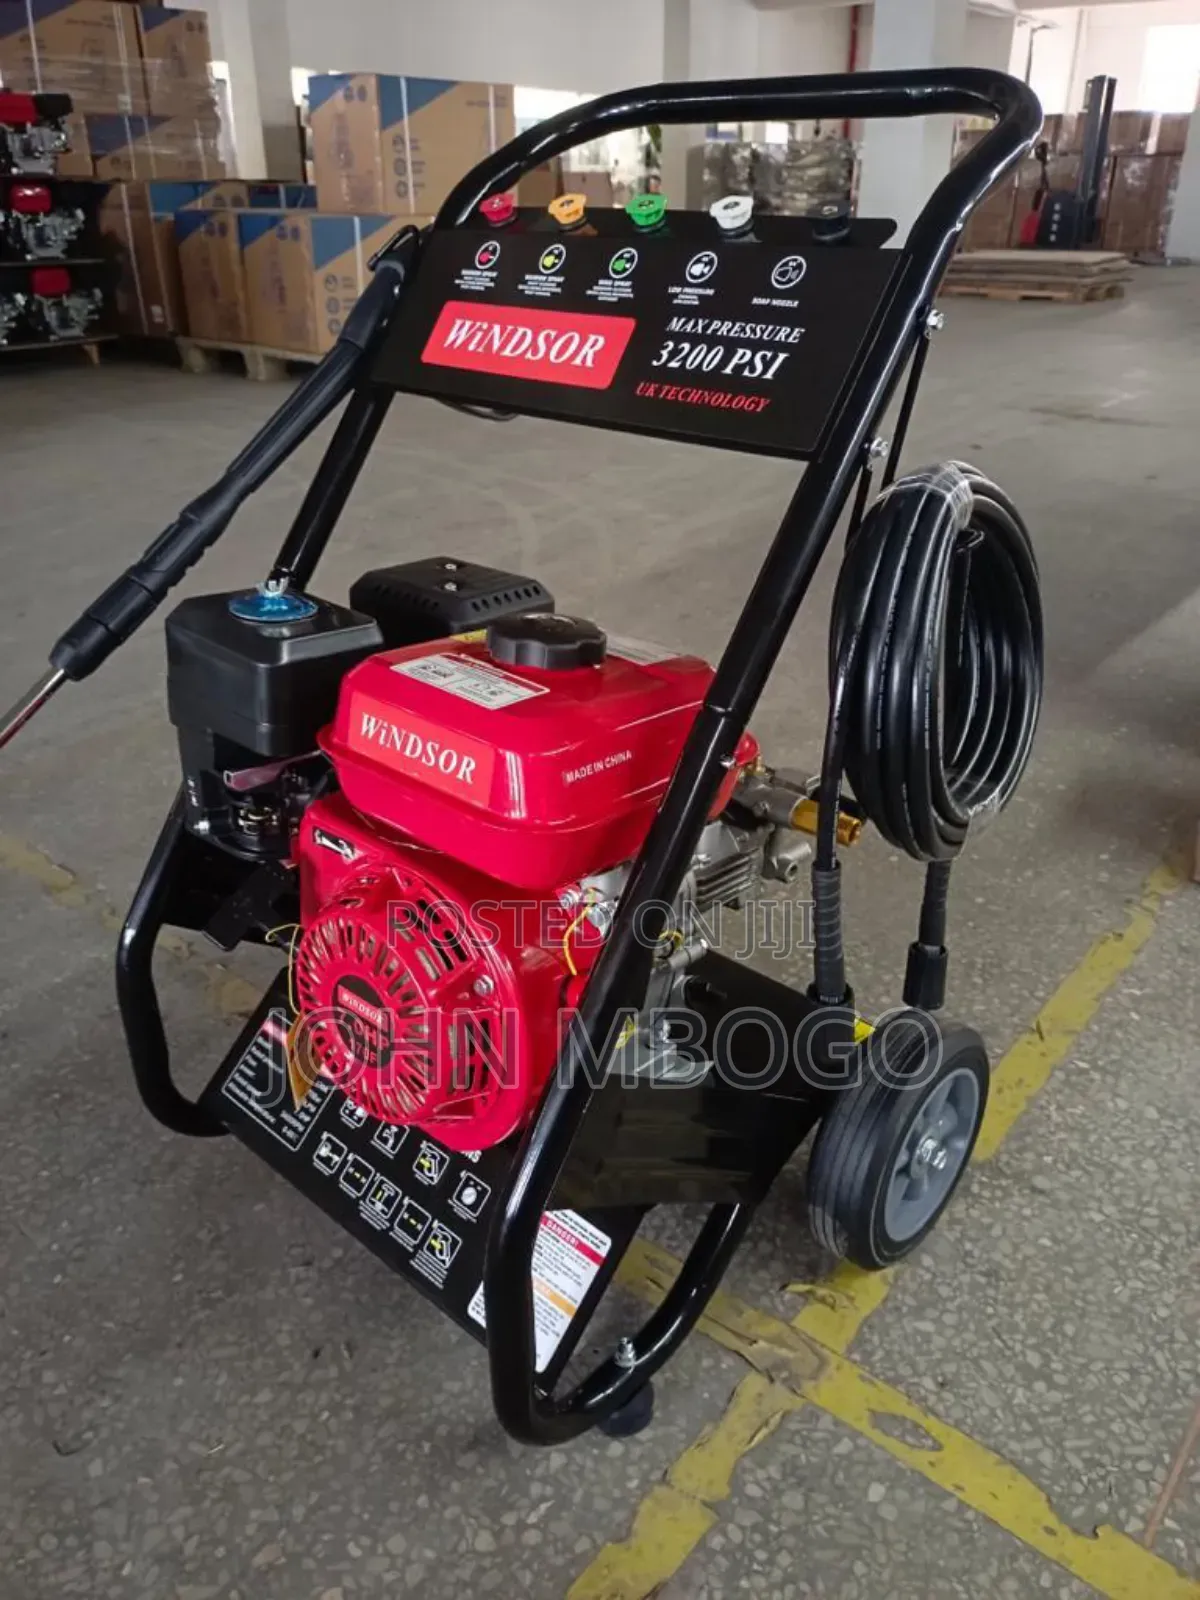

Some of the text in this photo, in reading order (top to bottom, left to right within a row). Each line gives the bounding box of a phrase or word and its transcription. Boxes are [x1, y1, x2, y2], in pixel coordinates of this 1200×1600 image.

[666, 316, 806, 344] MAX PRESSURE
[651, 340, 791, 381] 3200 PSI
[635, 381, 772, 413] UK TECHNOLOGY
[565, 749, 632, 783] MADE IN CHINA
